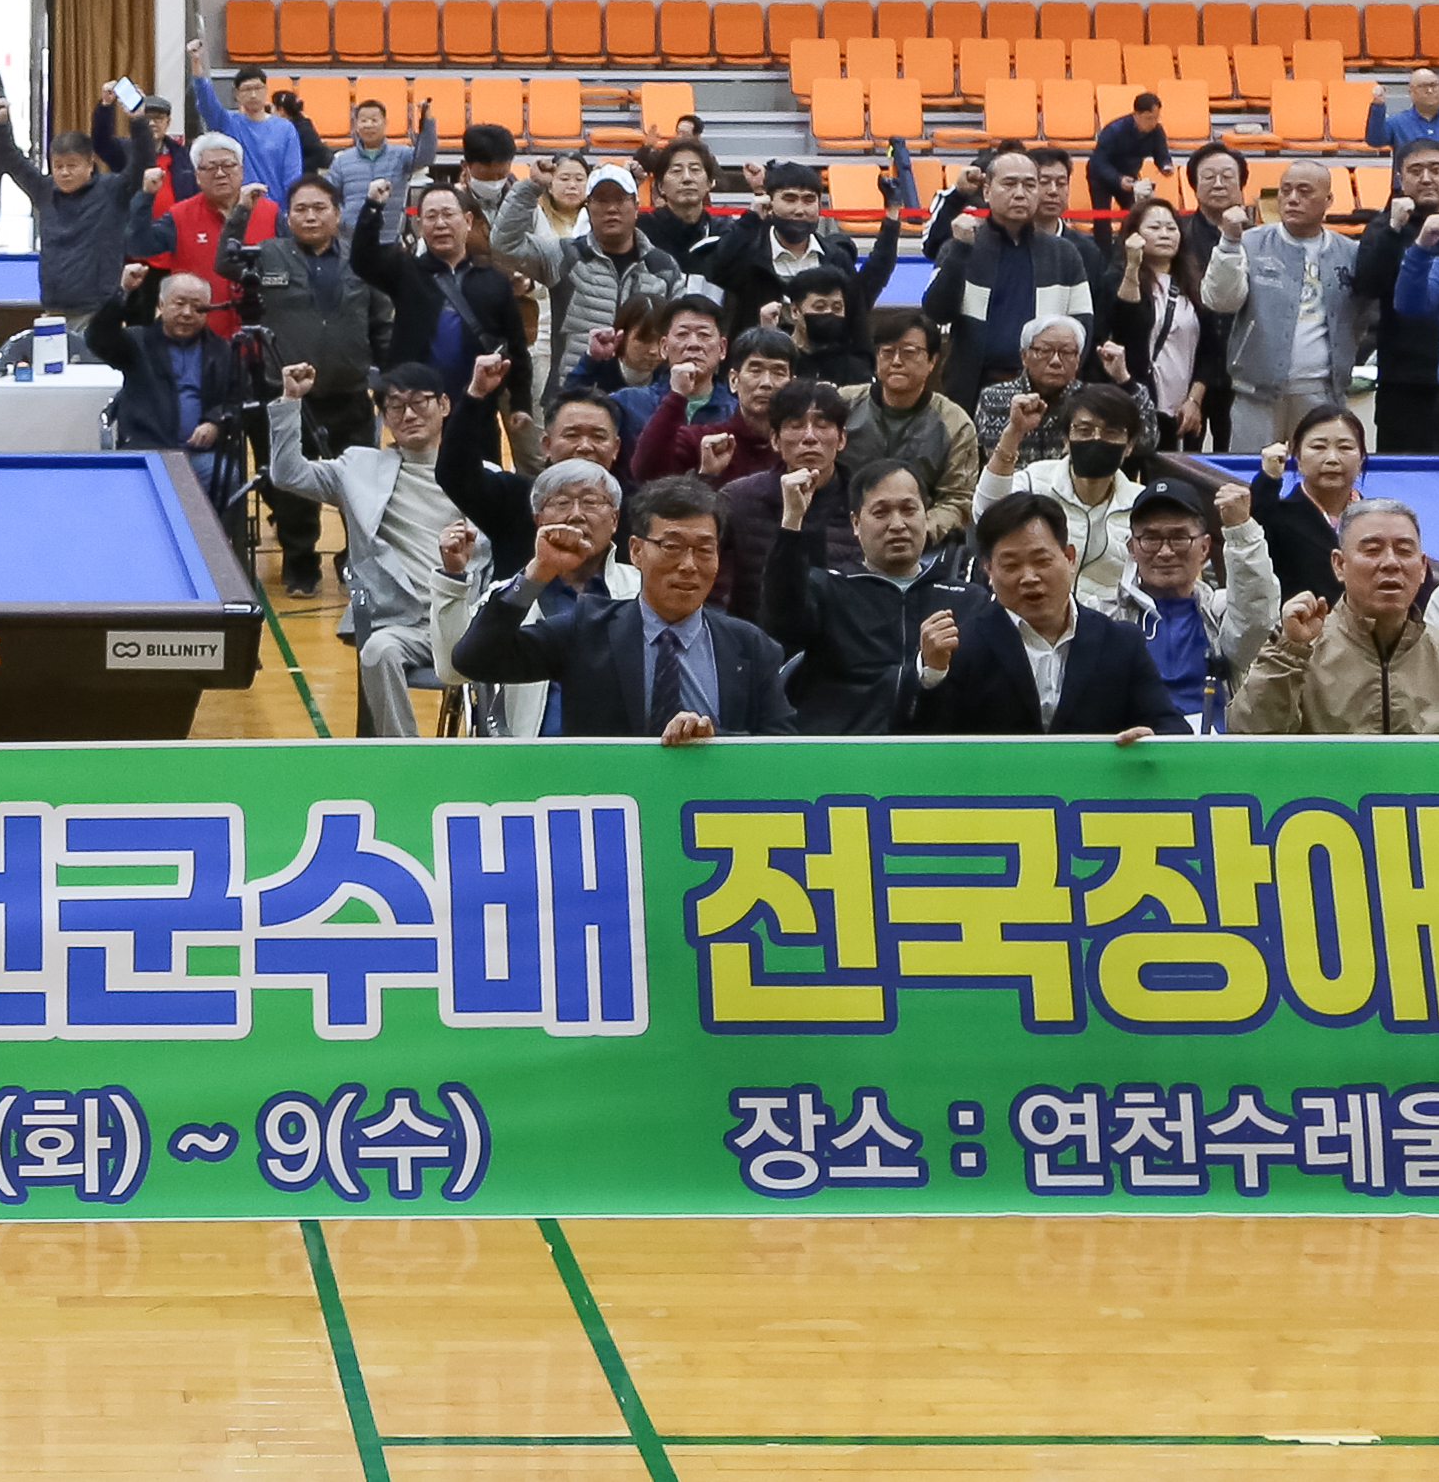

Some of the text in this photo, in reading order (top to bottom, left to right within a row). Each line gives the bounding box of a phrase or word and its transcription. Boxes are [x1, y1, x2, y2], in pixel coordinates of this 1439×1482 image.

[145, 642, 218, 660] BILLINITY
[264, 1088, 485, 1197] 9(수)
[732, 1091, 924, 1188] 장소
